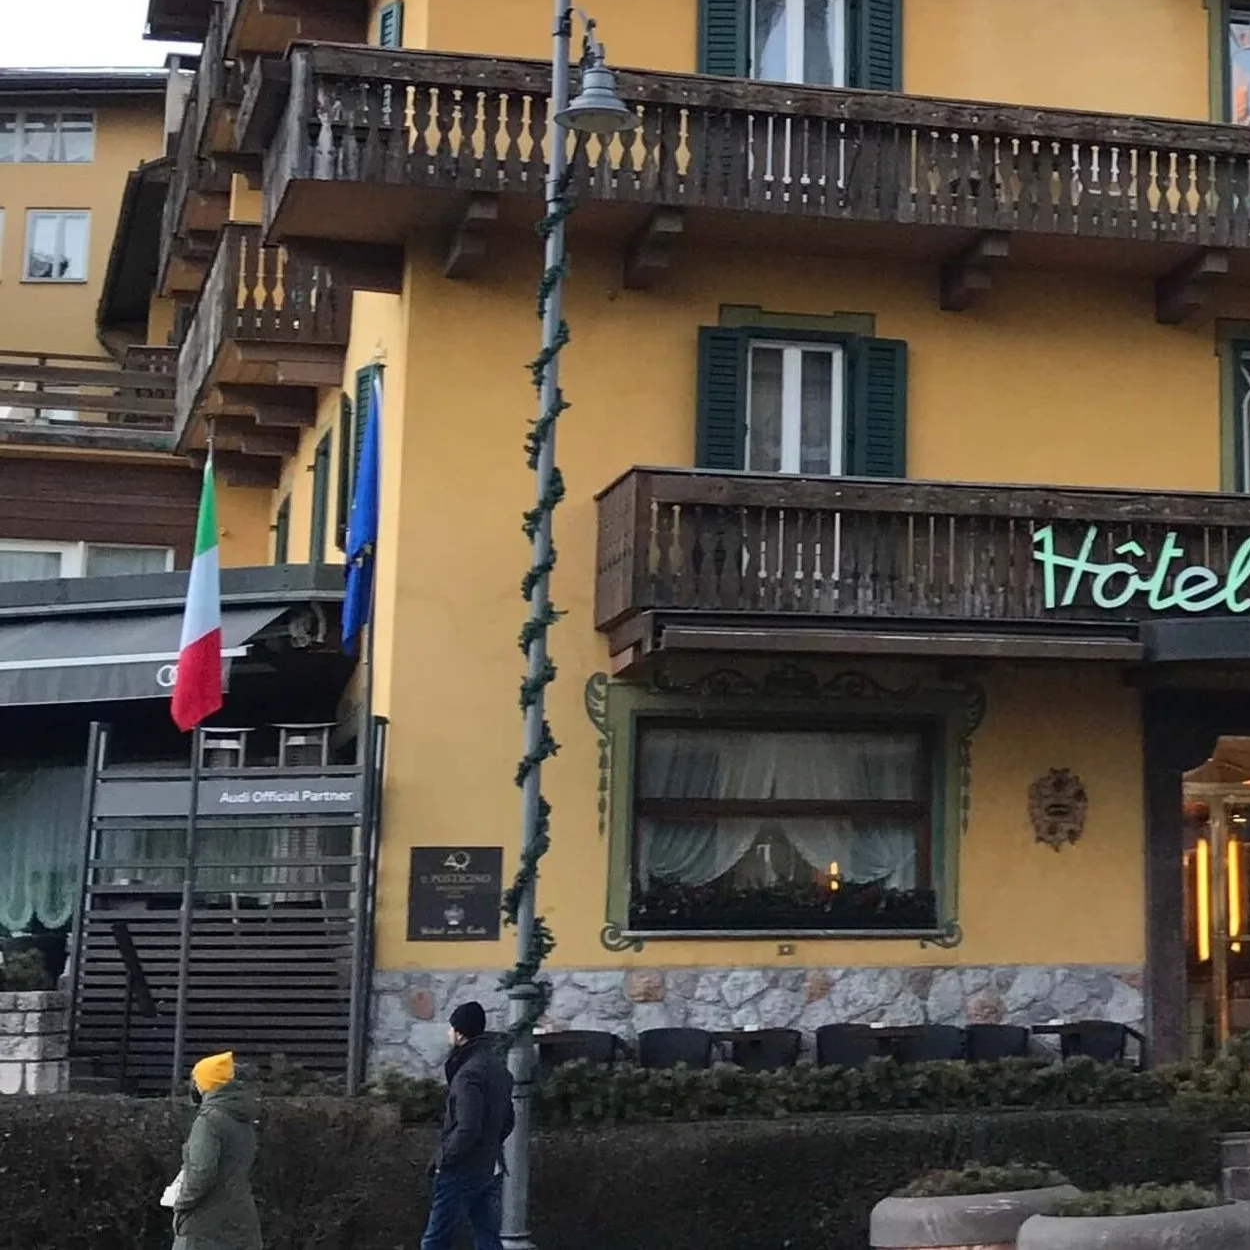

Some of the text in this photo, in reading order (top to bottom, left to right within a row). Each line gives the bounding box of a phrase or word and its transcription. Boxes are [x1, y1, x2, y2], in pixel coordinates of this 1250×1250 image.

[219, 790, 354, 803] Audi Official Partner
